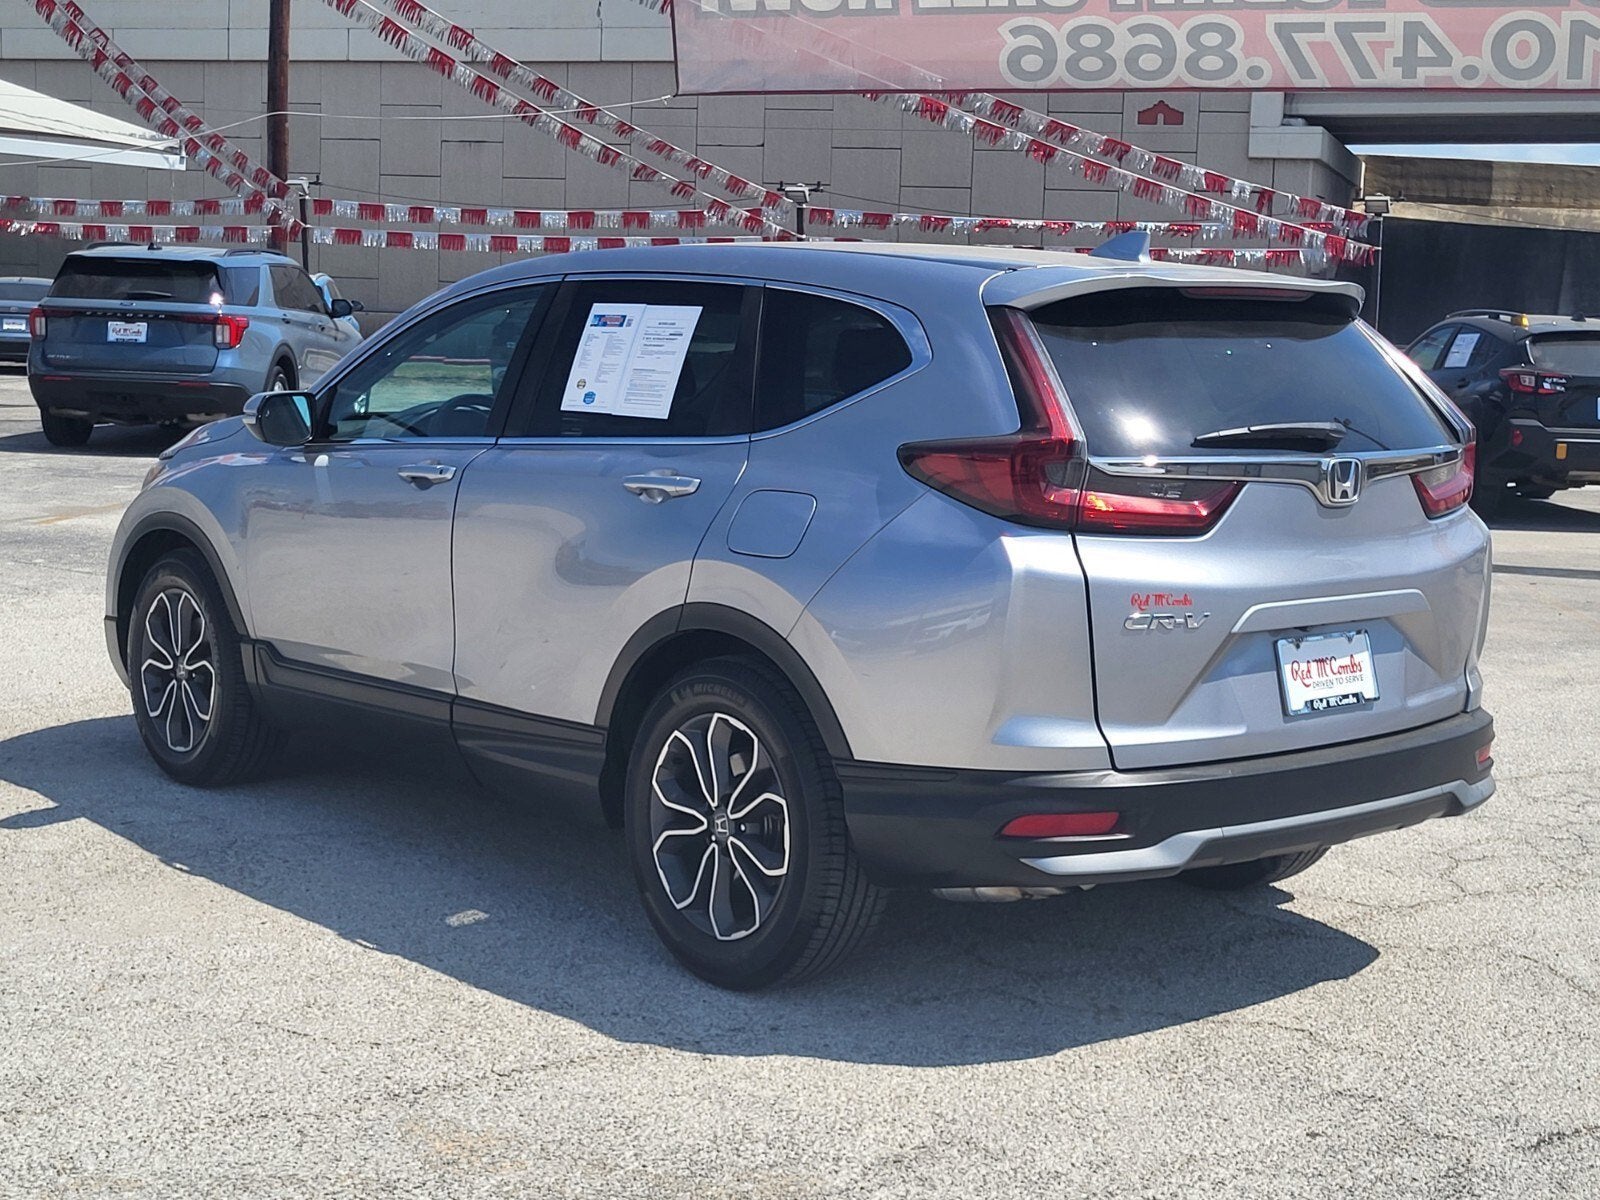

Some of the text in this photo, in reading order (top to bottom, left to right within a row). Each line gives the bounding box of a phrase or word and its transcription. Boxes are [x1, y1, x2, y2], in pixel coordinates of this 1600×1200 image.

[1130, 592, 1193, 611] Red McCombs
[1124, 612, 1211, 630] CR-V
[1291, 654, 1363, 688] Red McCombs
[1312, 674, 1364, 689] DRIVEN TO SERVE
[1313, 698, 1328, 710] Red
